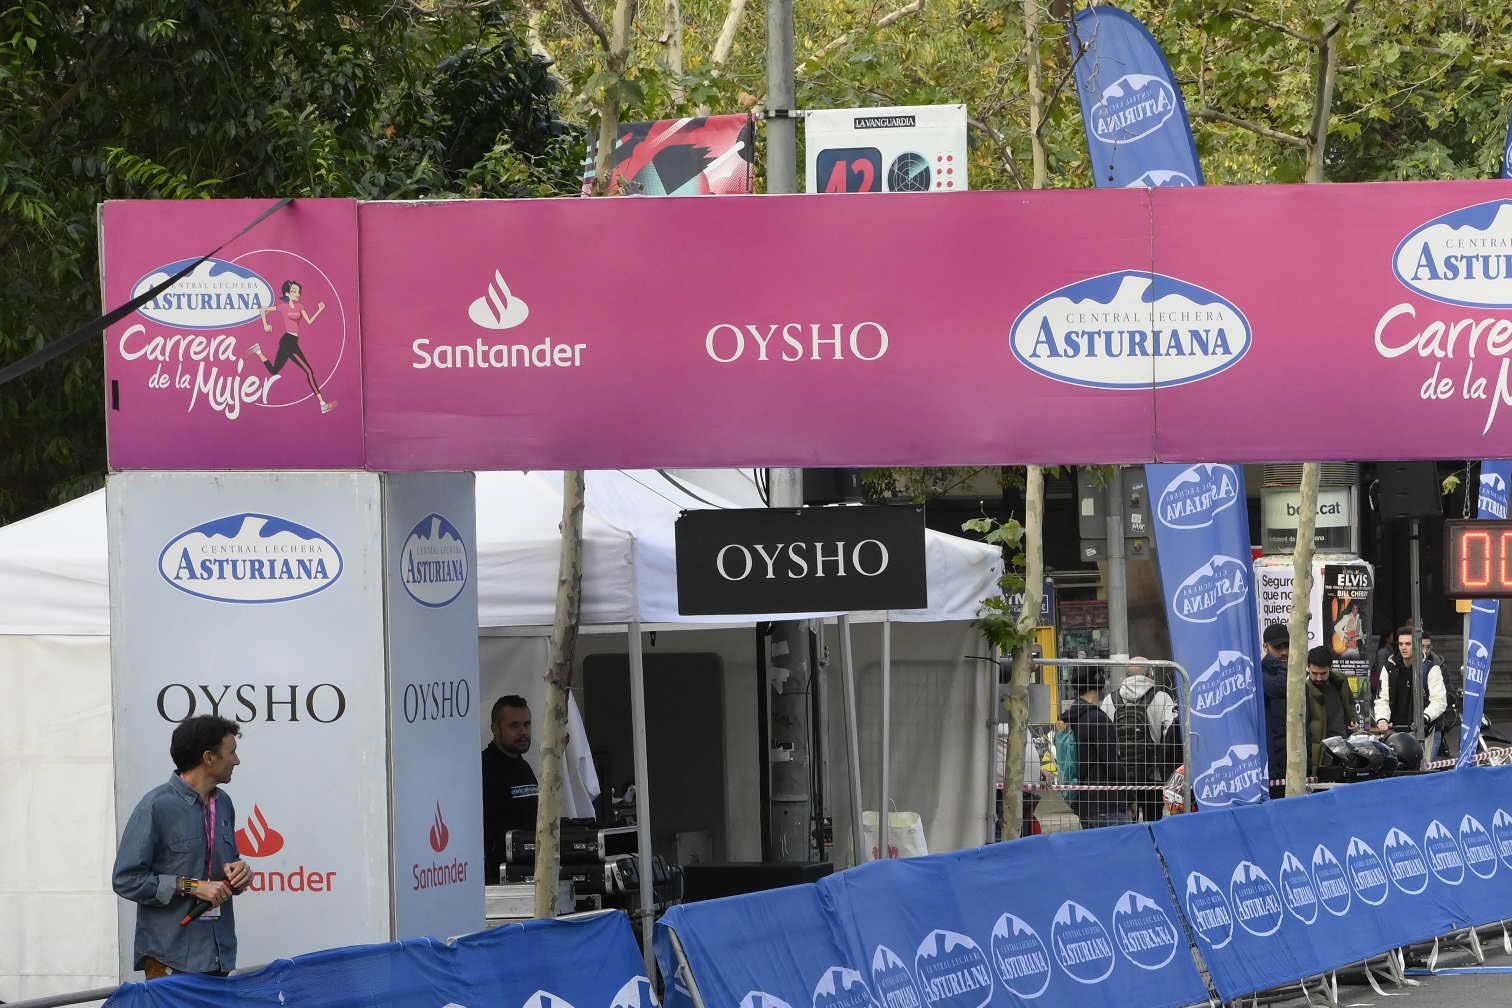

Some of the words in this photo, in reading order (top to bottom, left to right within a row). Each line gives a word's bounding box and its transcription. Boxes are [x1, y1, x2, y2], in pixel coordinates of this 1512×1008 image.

[855, 119, 865, 128] LA
[865, 117, 915, 128] VANGUARDIA
[143, 283, 263, 312] ASTURIANA
[171, 281, 208, 289] ENTRAL
[1065, 312, 1143, 324] CENTRAL
[1148, 312, 1225, 323] LECHERA
[119, 323, 237, 361] Carrera
[411, 336, 587, 370] Santander
[704, 321, 890, 364] OYSHO
[1028, 315, 1233, 360] ASTURIANA
[148, 362, 170, 389] de
[175, 361, 191, 389] la
[187, 358, 282, 420] Mujer
[1419, 362, 1455, 400] de
[1462, 360, 1488, 400] la
[1286, 501, 1341, 517] b.cat
[173, 546, 332, 582] ASTURIANA
[201, 545, 258, 554] CENTRAL
[265, 544, 323, 553] LECHERA
[405, 547, 465, 584] ASTURIANA
[715, 539, 889, 582] OYSHO
[1337, 573, 1368, 587] ELVIS
[1263, 604, 1295, 615] quiere
[156, 682, 347, 724] OYSHO
[403, 678, 470, 724] OYSHO
[243, 865, 337, 893] ander
[412, 857, 469, 890] Santander
[1057, 934, 1112, 967] ASTURIANA
[920, 964, 991, 1003] ASTURIANA
